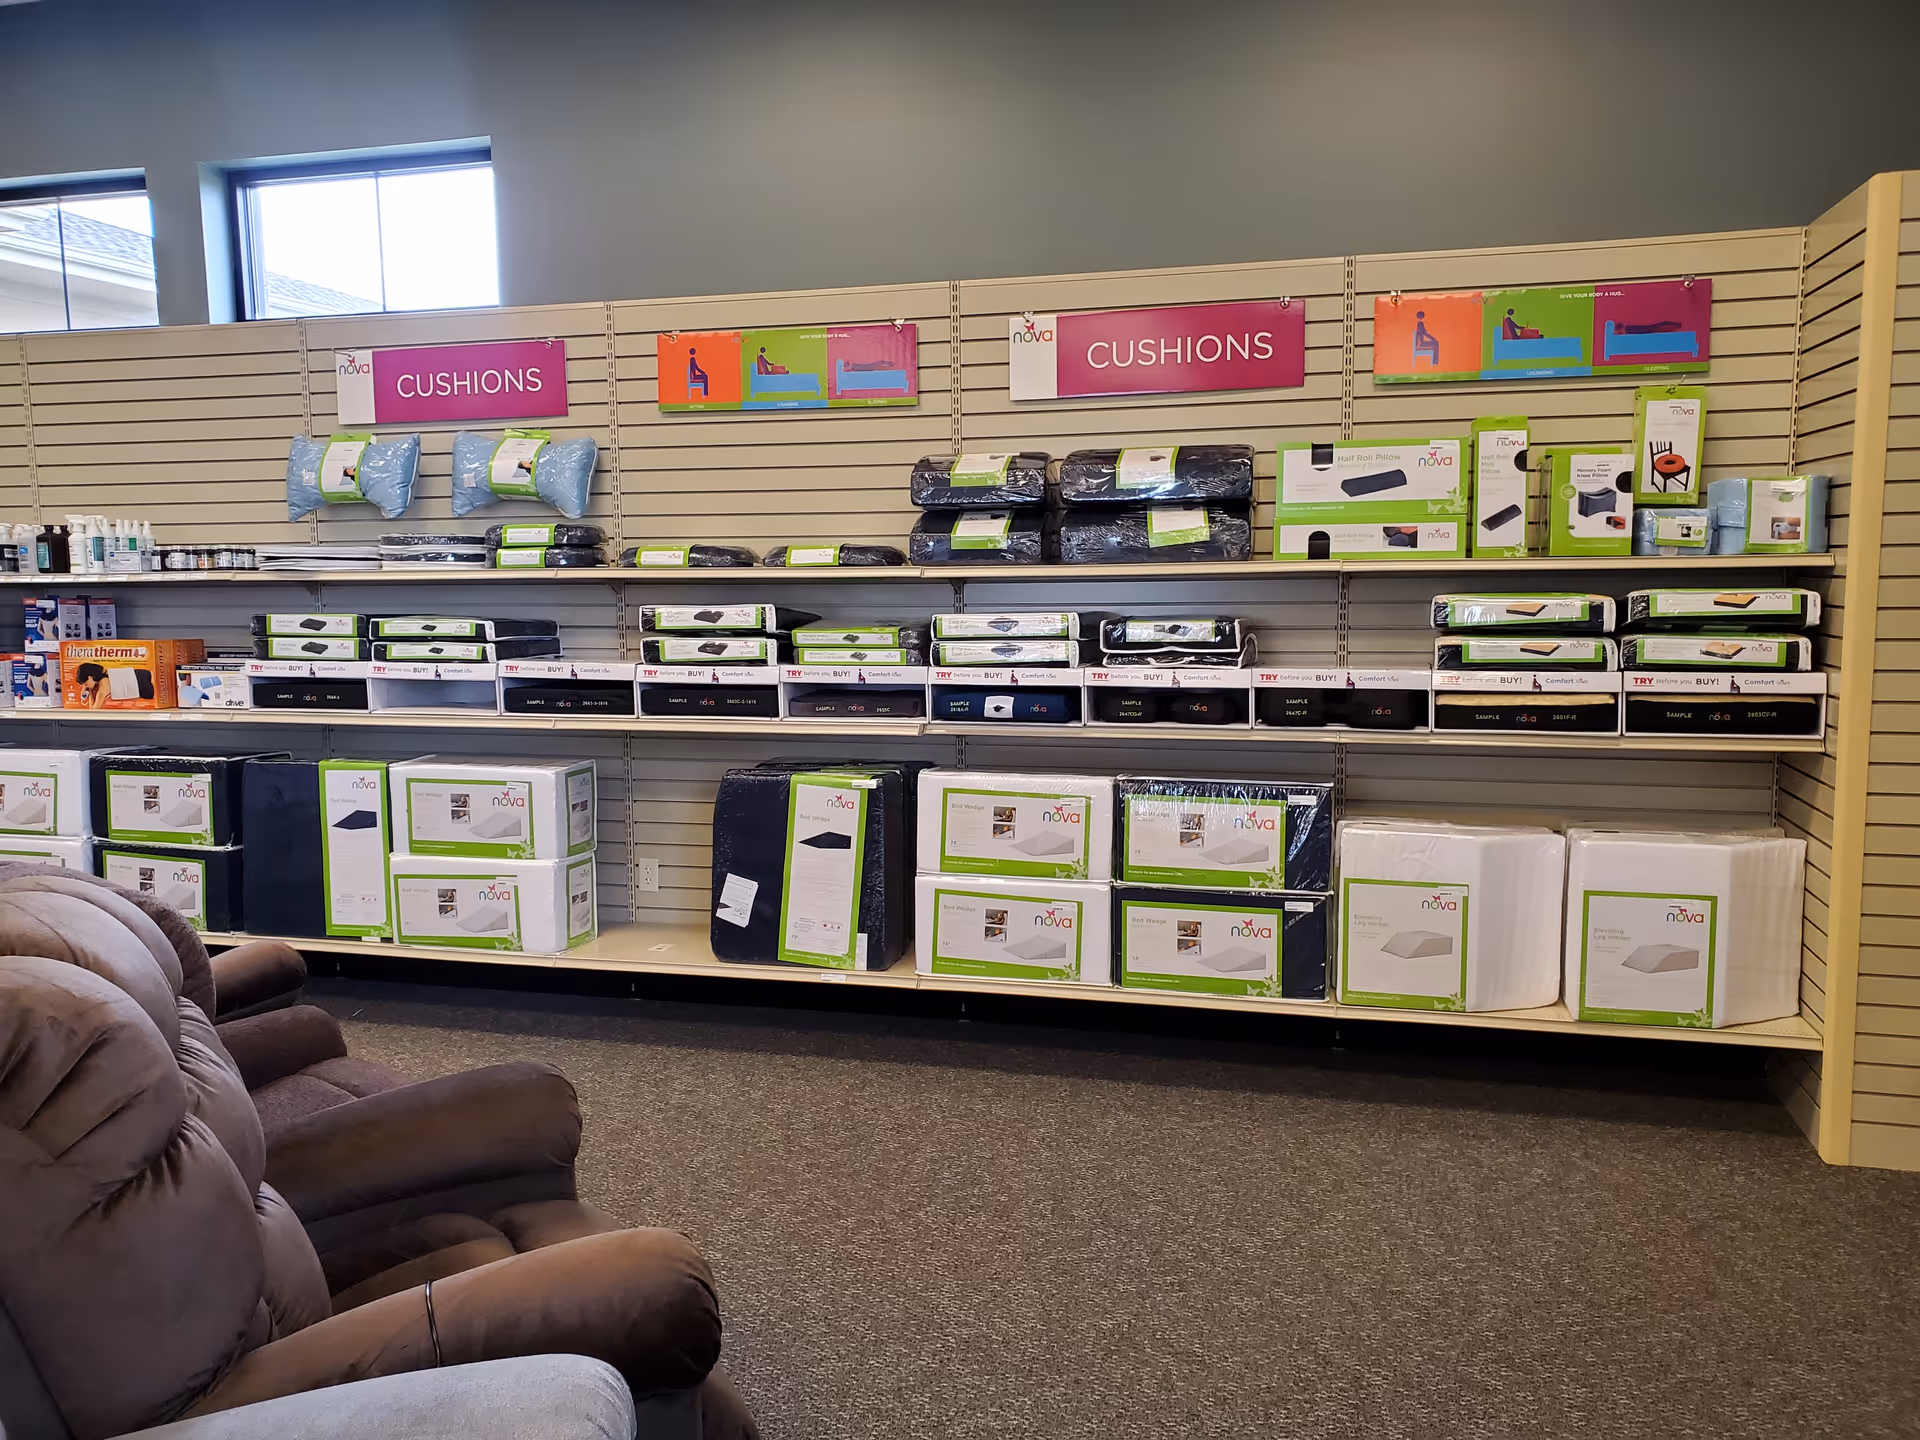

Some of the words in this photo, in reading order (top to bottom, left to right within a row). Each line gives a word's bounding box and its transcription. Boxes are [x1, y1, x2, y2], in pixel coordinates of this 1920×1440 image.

[1013, 330, 1053, 343] nova
[1087, 332, 1273, 369] CUSHIONS
[339, 363, 370, 376] nova
[397, 367, 542, 398] CUSHIONS
[1419, 456, 1452, 467] nova
[67, 644, 132, 658] theratherm
[225, 698, 244, 707] drive
[1189, 704, 1208, 712] nova
[352, 781, 376, 789] nova
[24, 787, 50, 797] nova
[178, 788, 205, 798] nova
[492, 797, 524, 807] nova
[827, 799, 854, 809] nova
[1043, 811, 1080, 824] nova
[1233, 818, 1274, 830] nova
[173, 872, 199, 883] nova
[479, 891, 510, 900] nova
[1422, 900, 1456, 910] nova
[1035, 915, 1072, 928] nova
[1667, 912, 1704, 923] nova
[1231, 926, 1271, 938] nova
